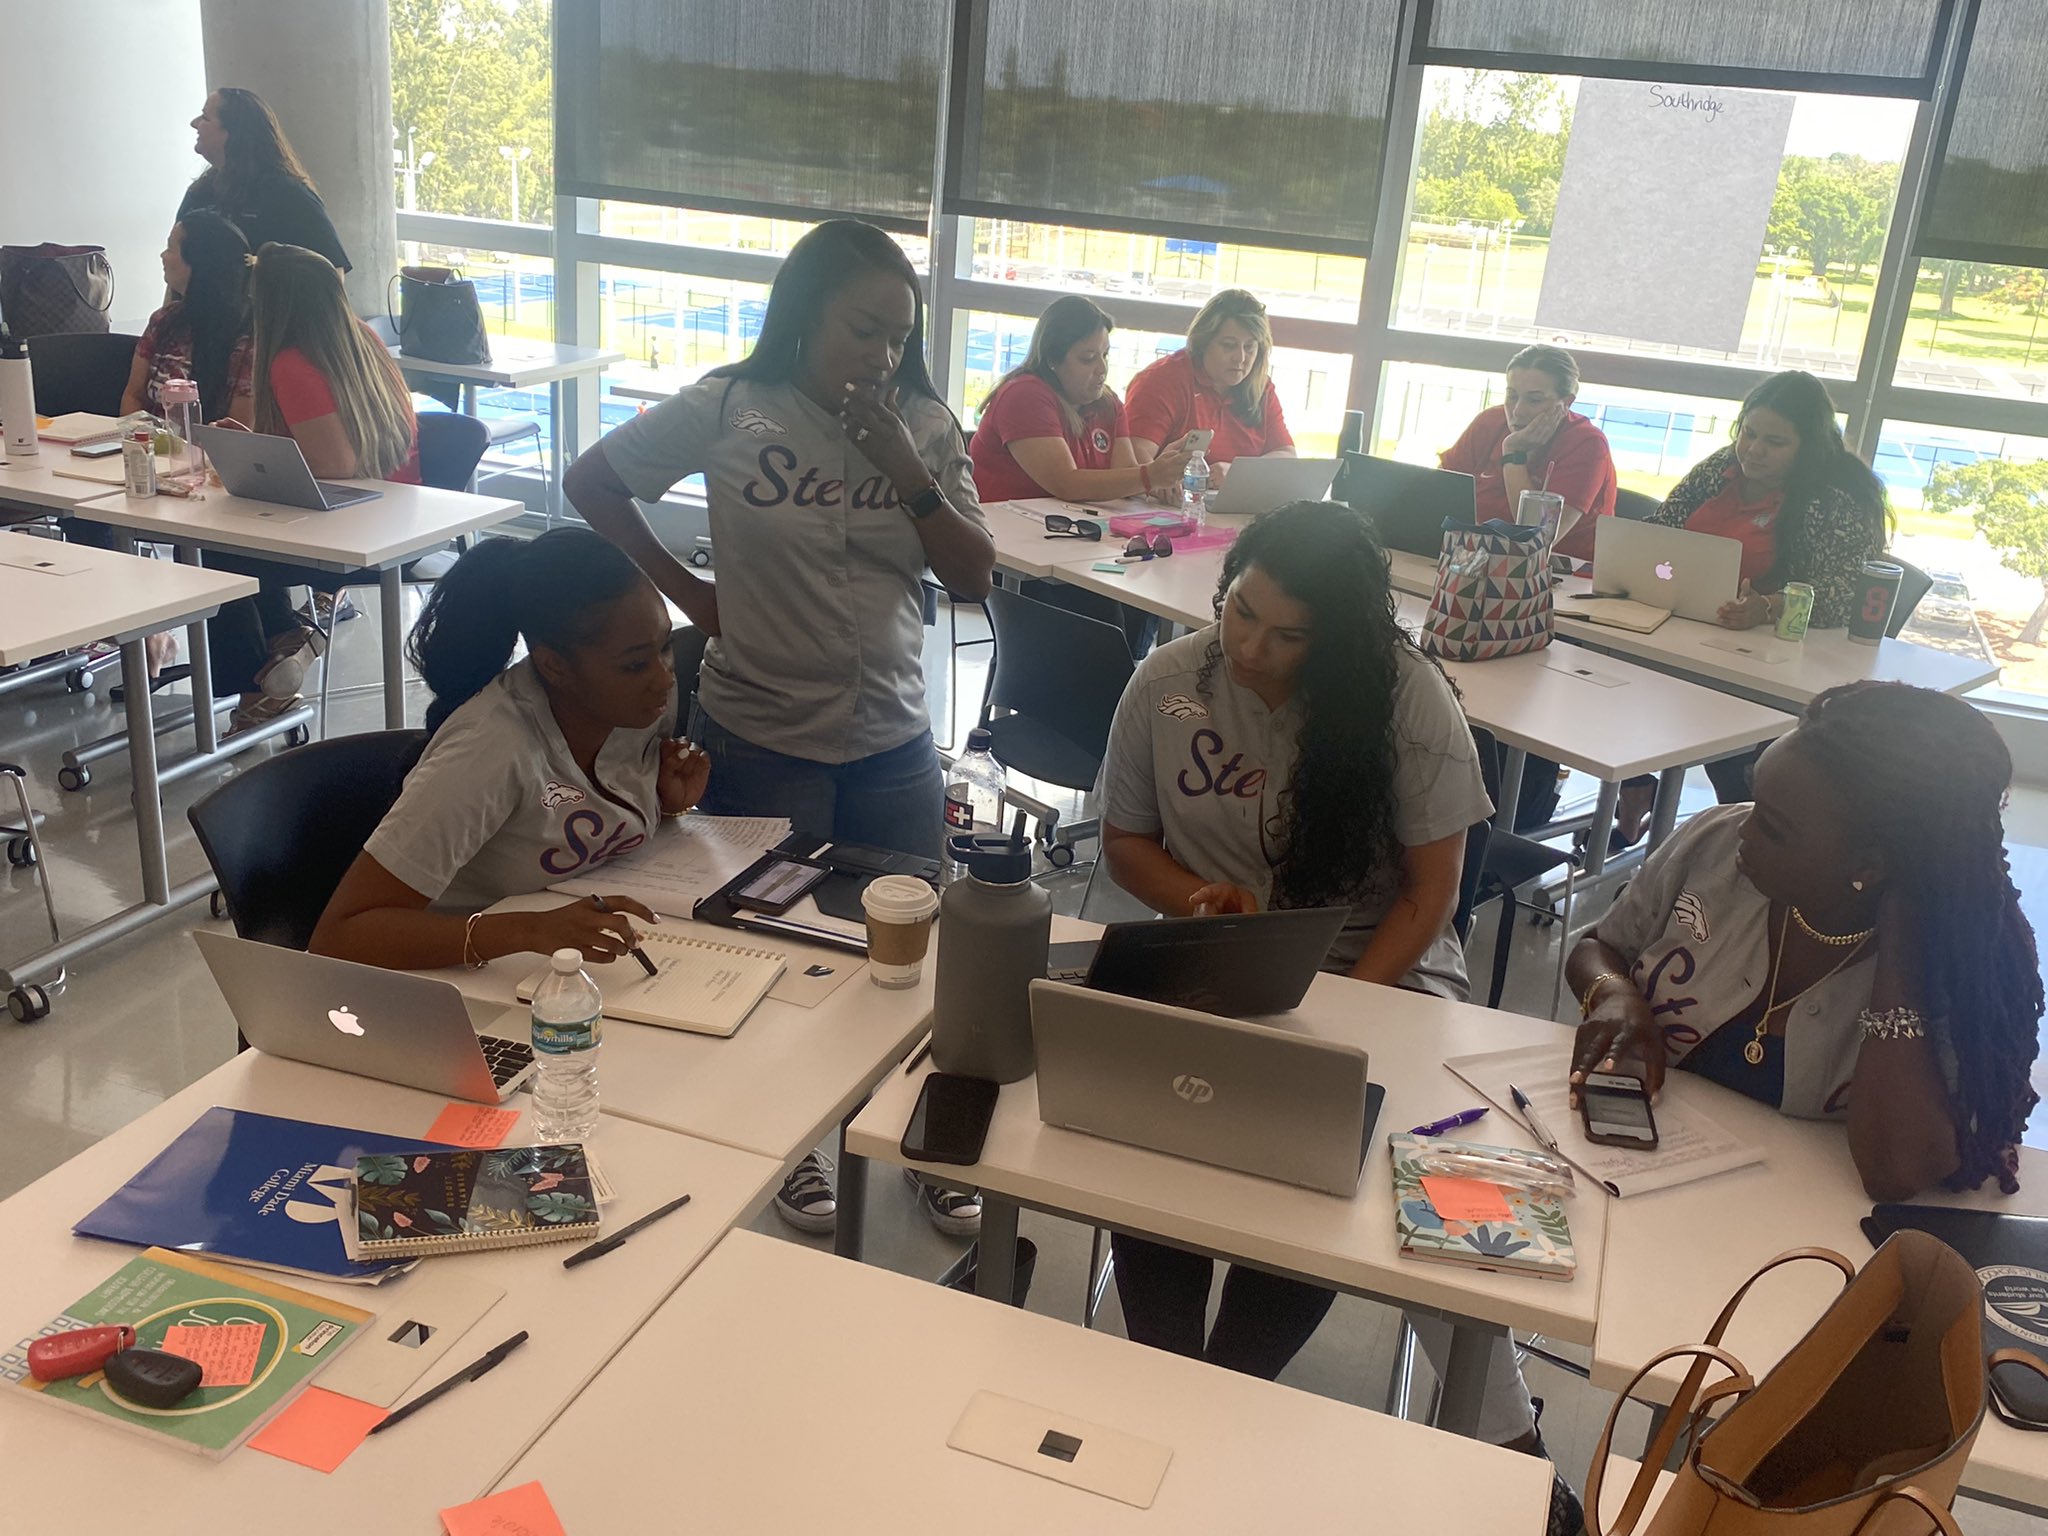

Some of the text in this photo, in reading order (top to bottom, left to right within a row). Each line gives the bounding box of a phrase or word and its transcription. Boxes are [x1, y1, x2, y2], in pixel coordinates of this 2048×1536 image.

[1647, 84, 1725, 123] Southridge
[1174, 1075, 1212, 1103] hp
[249, 1168, 290, 1203] College
[257, 1162, 318, 1216] Miami Dade
